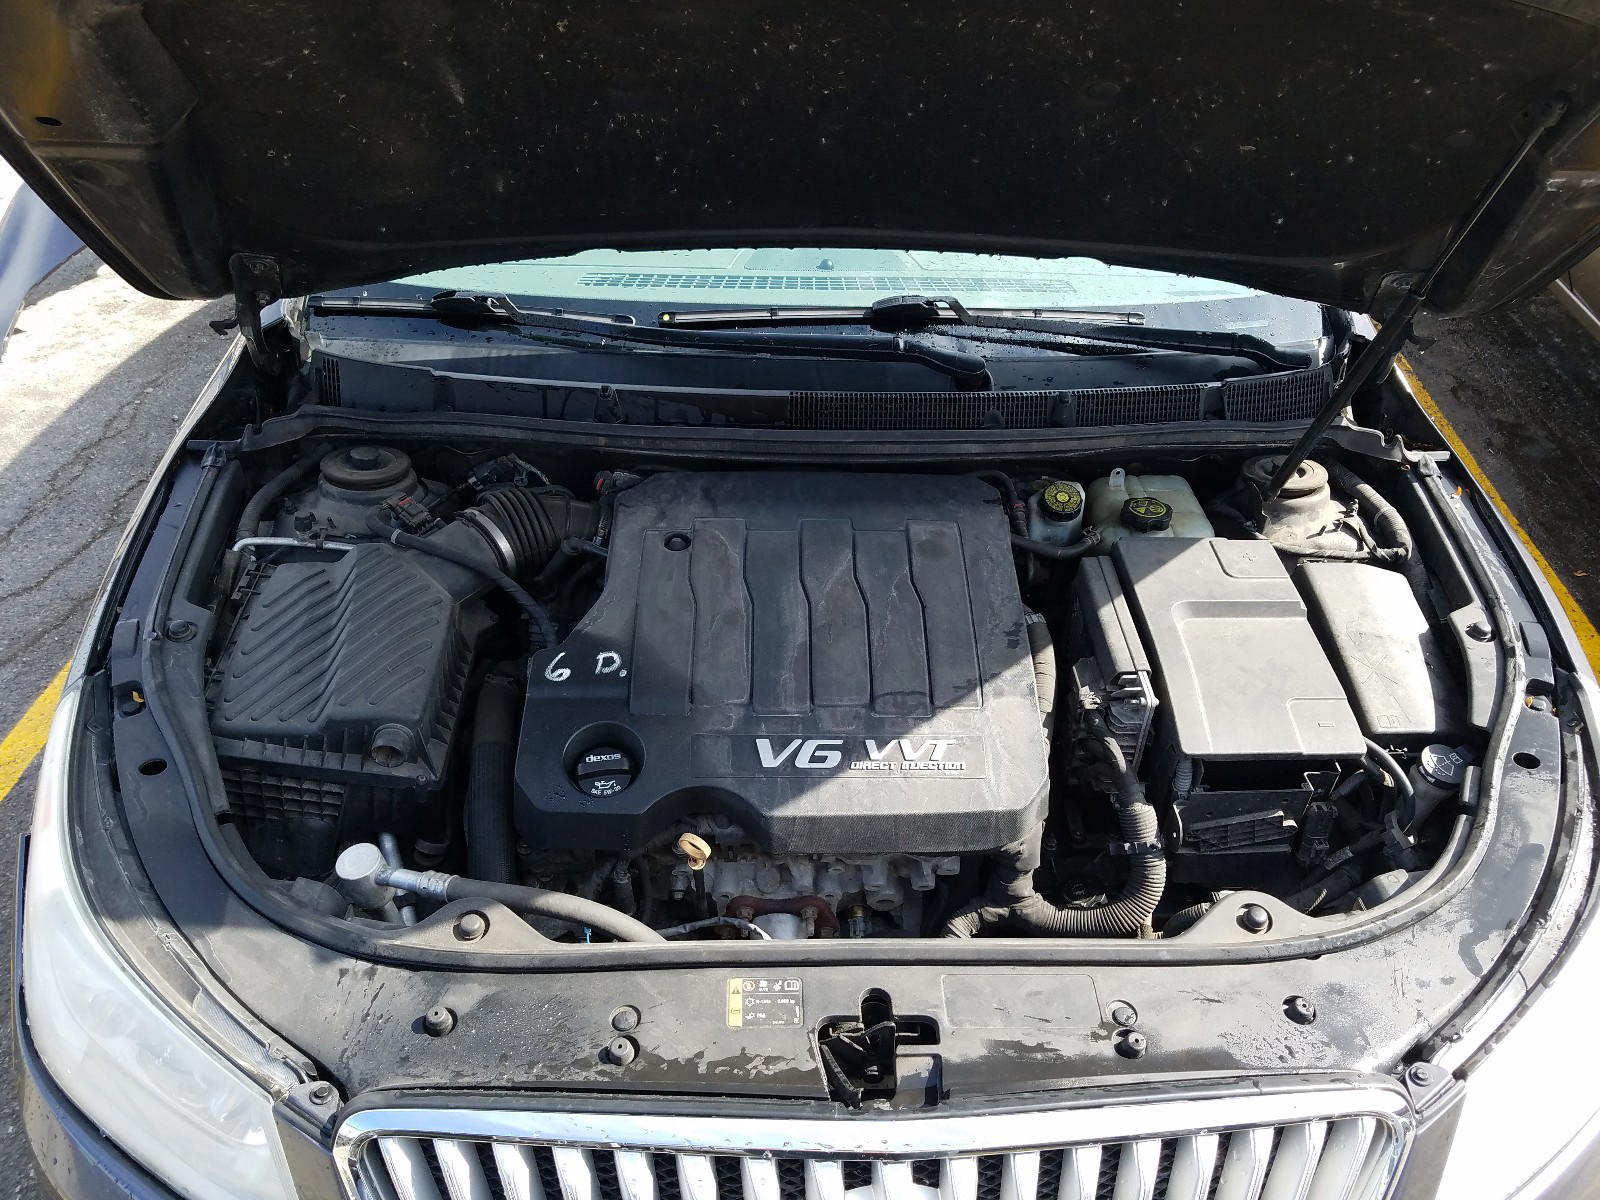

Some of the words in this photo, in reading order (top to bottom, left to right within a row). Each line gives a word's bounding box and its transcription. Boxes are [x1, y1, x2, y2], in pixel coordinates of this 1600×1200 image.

[545, 652, 572, 682] 6
[585, 753, 622, 763] dexos
[756, 738, 844, 768] V6
[865, 739, 957, 761] VVT
[851, 761, 897, 771] DIRECT
[901, 761, 968, 771] INJECTION
